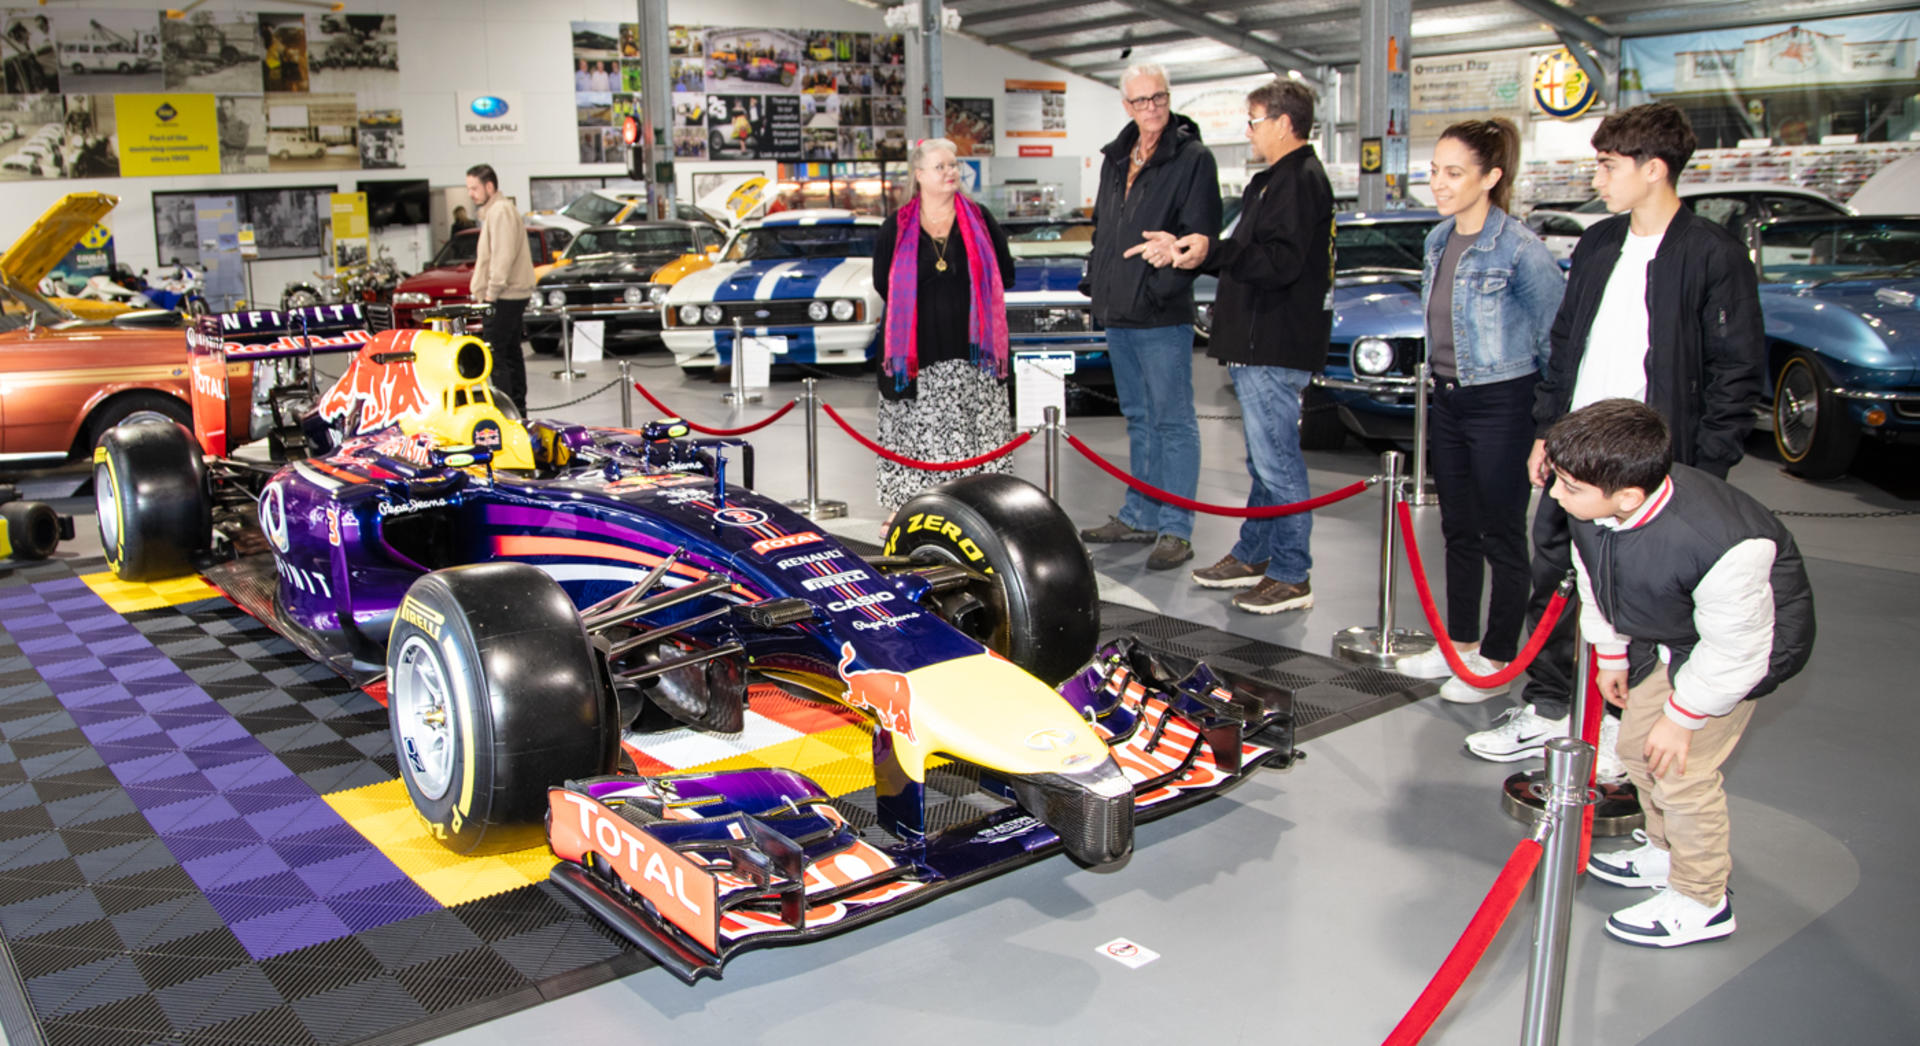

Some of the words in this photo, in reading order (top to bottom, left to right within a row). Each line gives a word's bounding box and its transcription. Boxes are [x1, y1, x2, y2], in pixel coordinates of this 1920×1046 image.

[1414, 63, 1463, 75] Owners
[1466, 59, 1490, 71] Day
[708, 95, 728, 120] 25
[149, 134, 165, 142] Part
[465, 123, 518, 132] SUBARU
[192, 365, 226, 400] TOTAL
[408, 498, 447, 511] Jeans
[327, 508, 341, 546] 3
[724, 510, 758, 524] 3
[756, 533, 824, 552] TOTAL
[906, 513, 985, 562] ZERO
[777, 549, 844, 570] RENAULT
[801, 570, 870, 591] PIRELLI
[826, 591, 896, 612] CASIO
[401, 594, 445, 641] PIRELLI
[884, 612, 920, 627] Jeans
[563, 793, 701, 916] TOTAL
